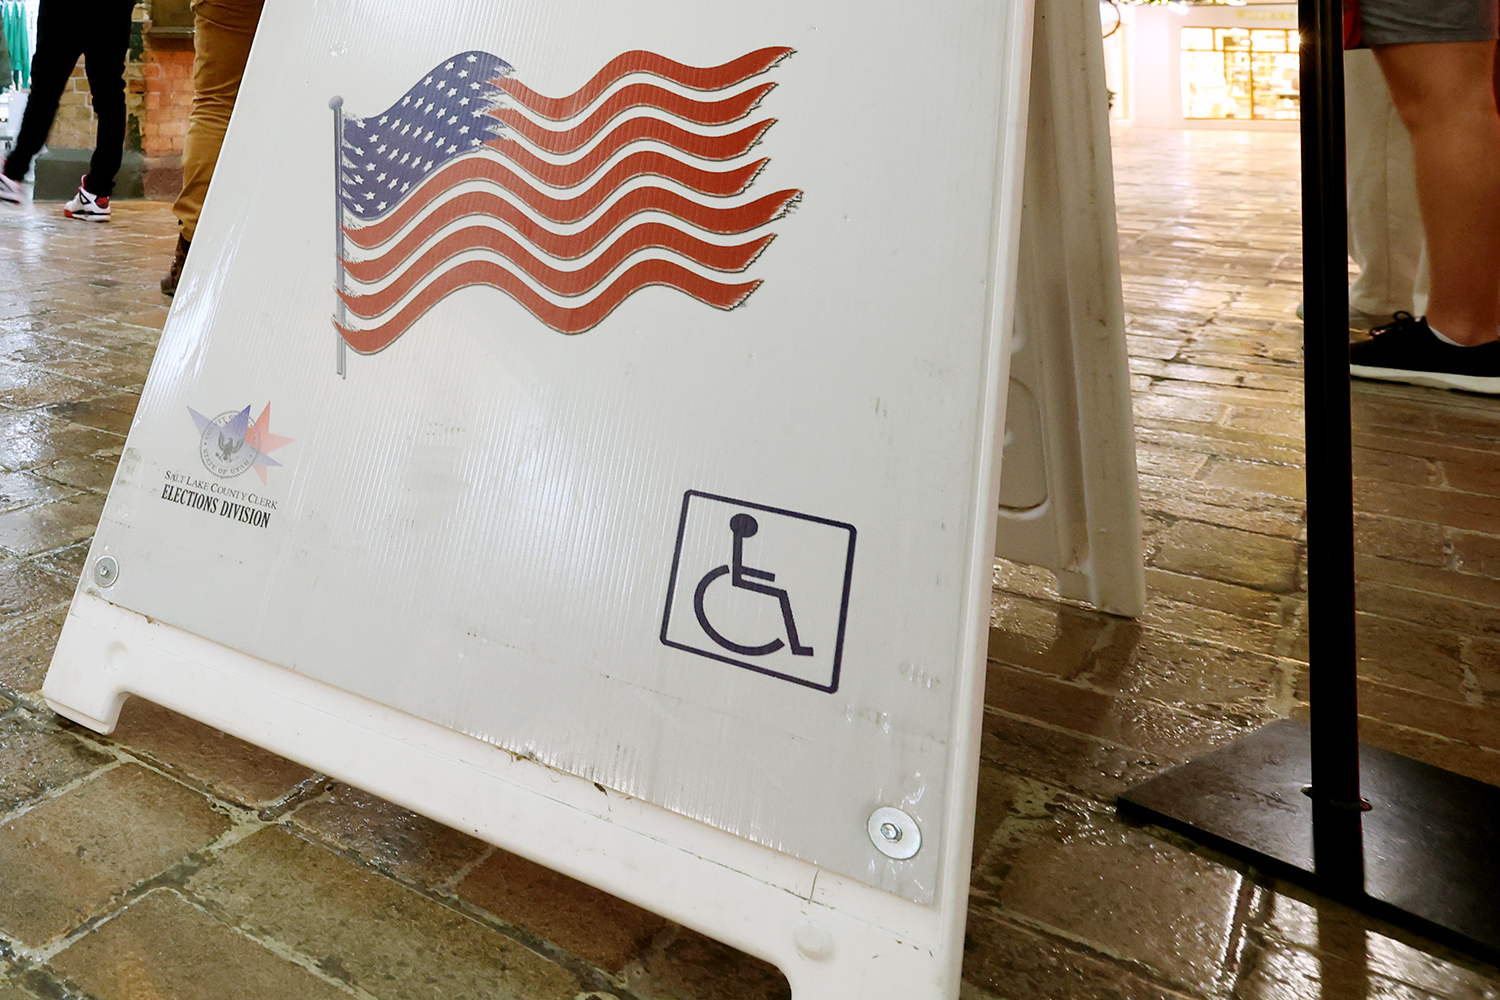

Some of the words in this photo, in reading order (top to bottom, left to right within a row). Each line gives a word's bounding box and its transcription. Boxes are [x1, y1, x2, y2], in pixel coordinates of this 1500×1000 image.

[161, 484, 219, 514] ELECTIONS
[219, 501, 271, 529] DIVISION
[164, 470, 186, 484] SALT
[186, 475, 209, 491] LAKE
[210, 483, 248, 501] COUNTY
[247, 493, 278, 510] CLERK
